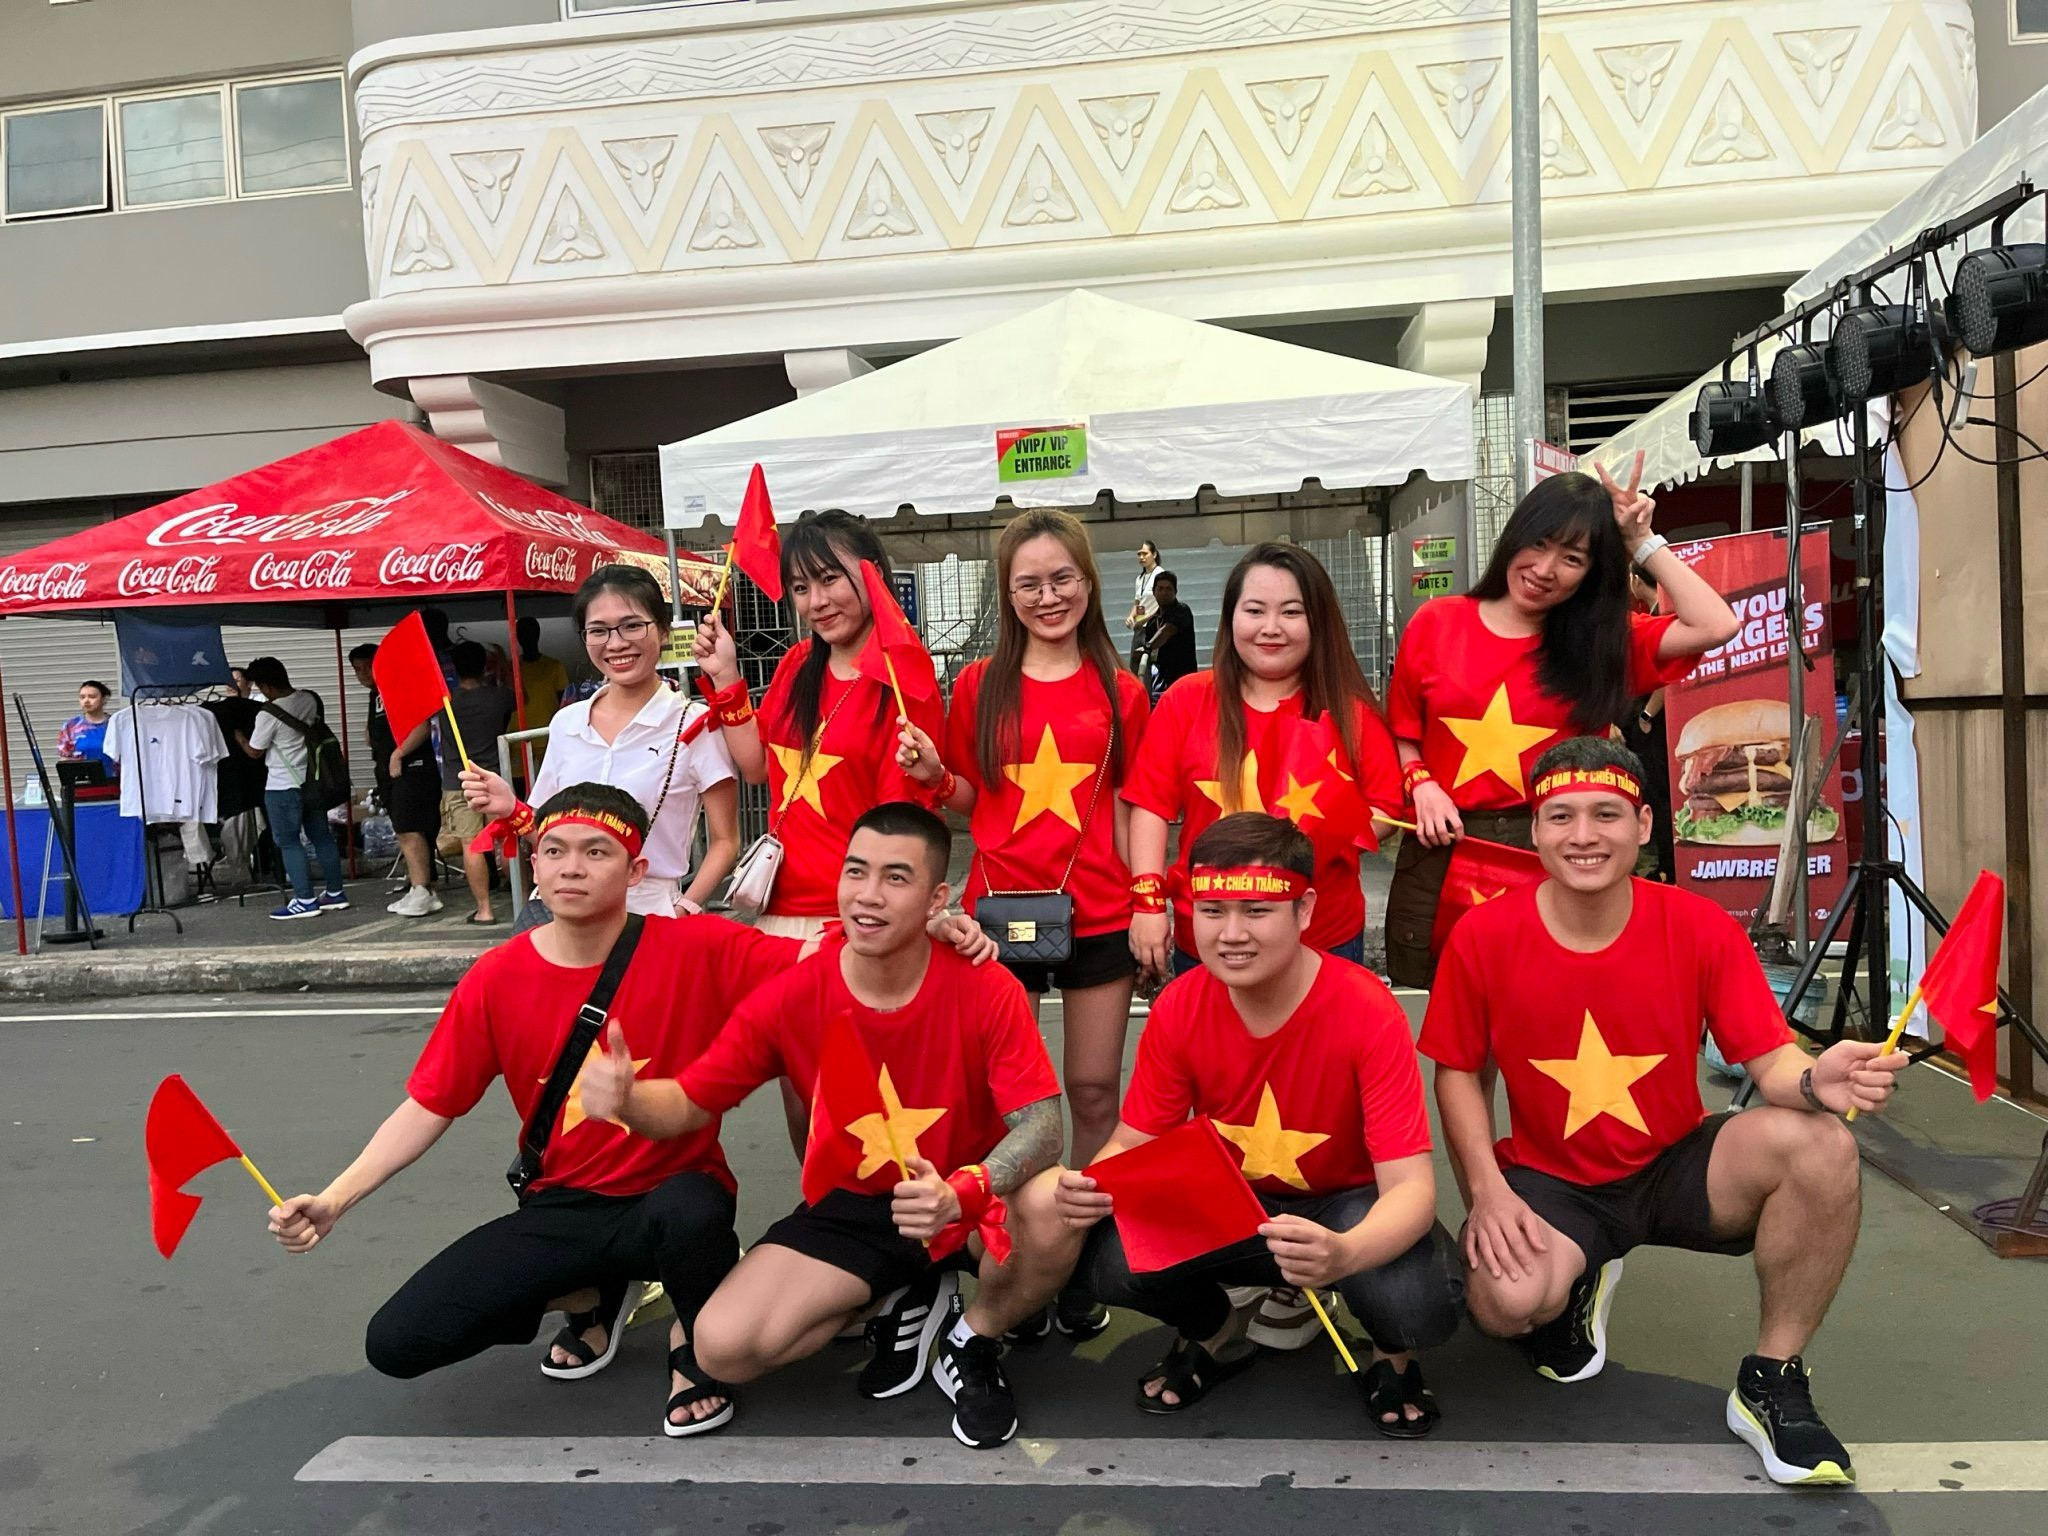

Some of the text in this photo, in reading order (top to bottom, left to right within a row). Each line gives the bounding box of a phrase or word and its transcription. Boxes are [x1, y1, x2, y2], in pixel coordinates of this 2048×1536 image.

[1015, 436, 1069, 454] VVIP/ VIP
[1014, 455, 1072, 474] ENTRANCE
[146, 487, 421, 547] Coca-Cola
[118, 555, 222, 596] Coca-Cola
[250, 549, 357, 591] Coca-Cola
[380, 543, 488, 585] Coca-Cola
[525, 542, 577, 583] Coca-Cola
[1418, 577, 1448, 590] GATE 3
[1699, 658, 1726, 677] THE
[1730, 647, 1767, 668] NEXT
[1691, 854, 1831, 880] JAWBREER
